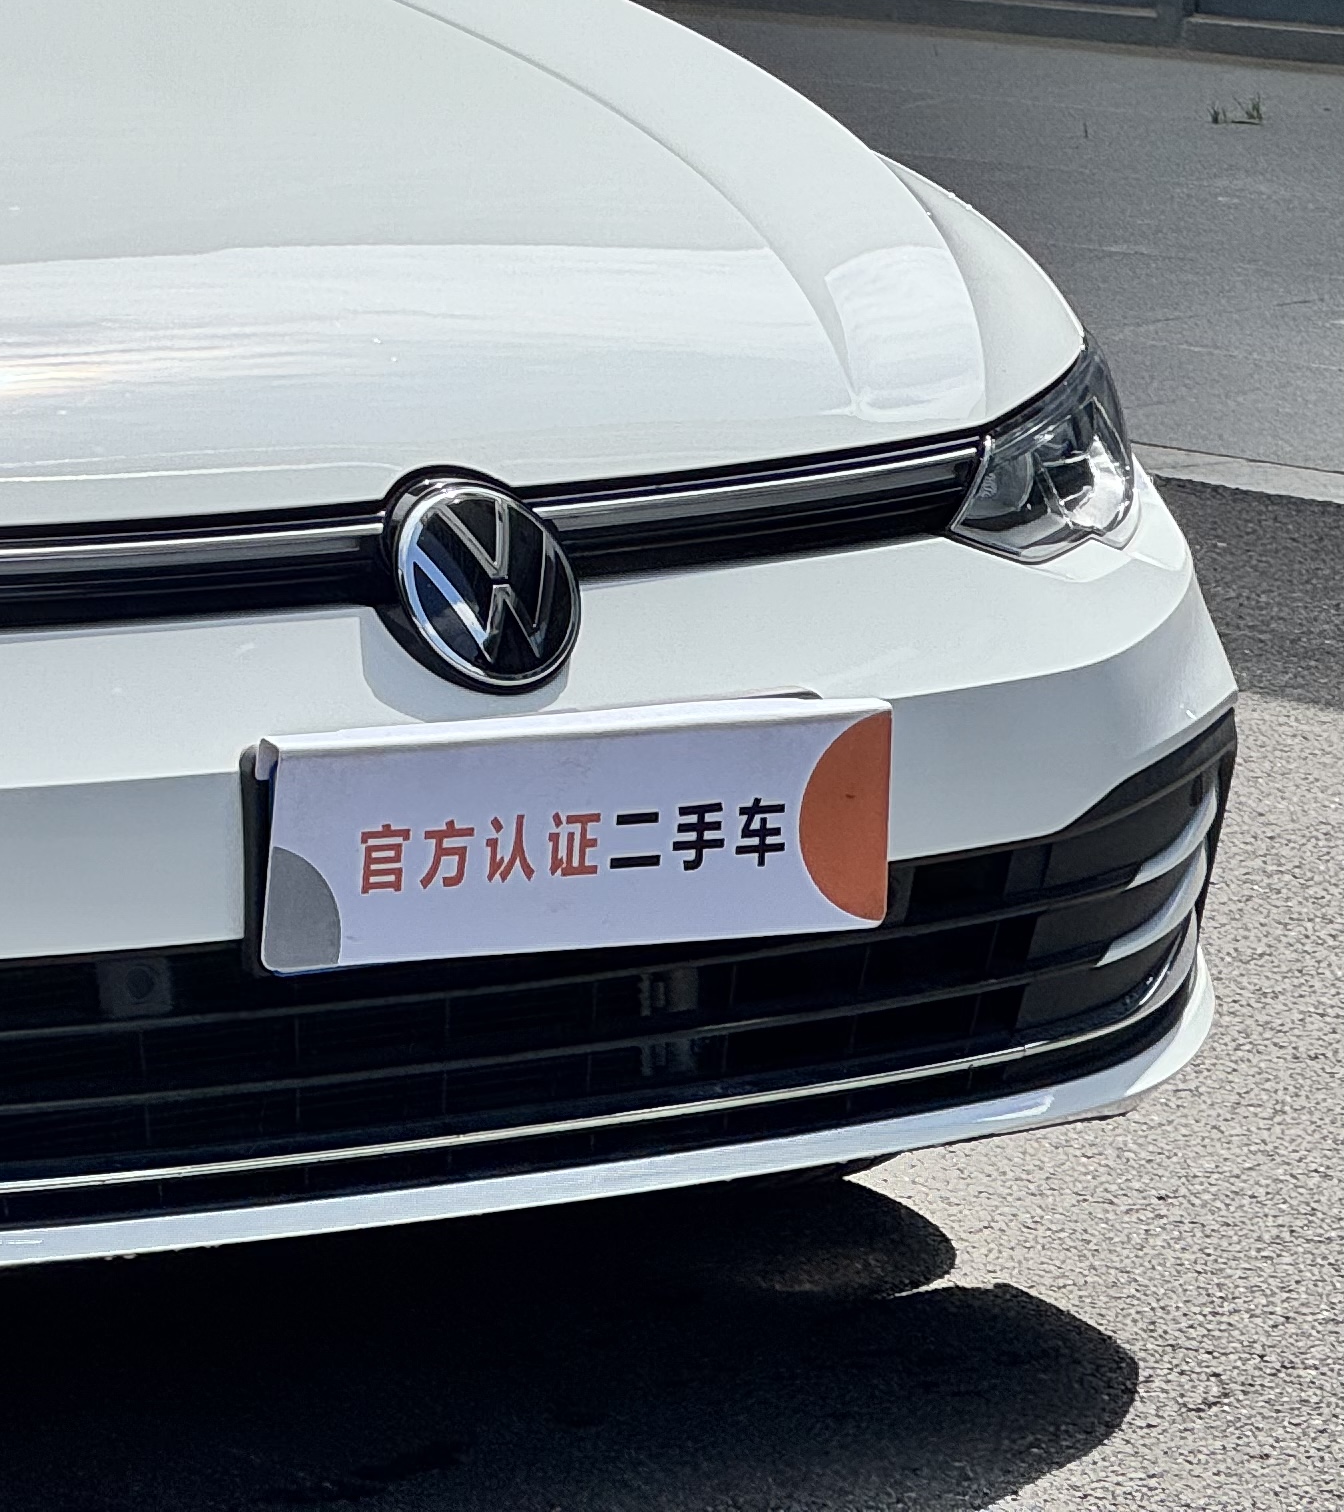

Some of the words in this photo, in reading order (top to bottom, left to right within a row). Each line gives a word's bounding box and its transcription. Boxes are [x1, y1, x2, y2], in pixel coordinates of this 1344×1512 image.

[399, 486, 581, 686] VW
[360, 797, 786, 895] 官方认证二手车
